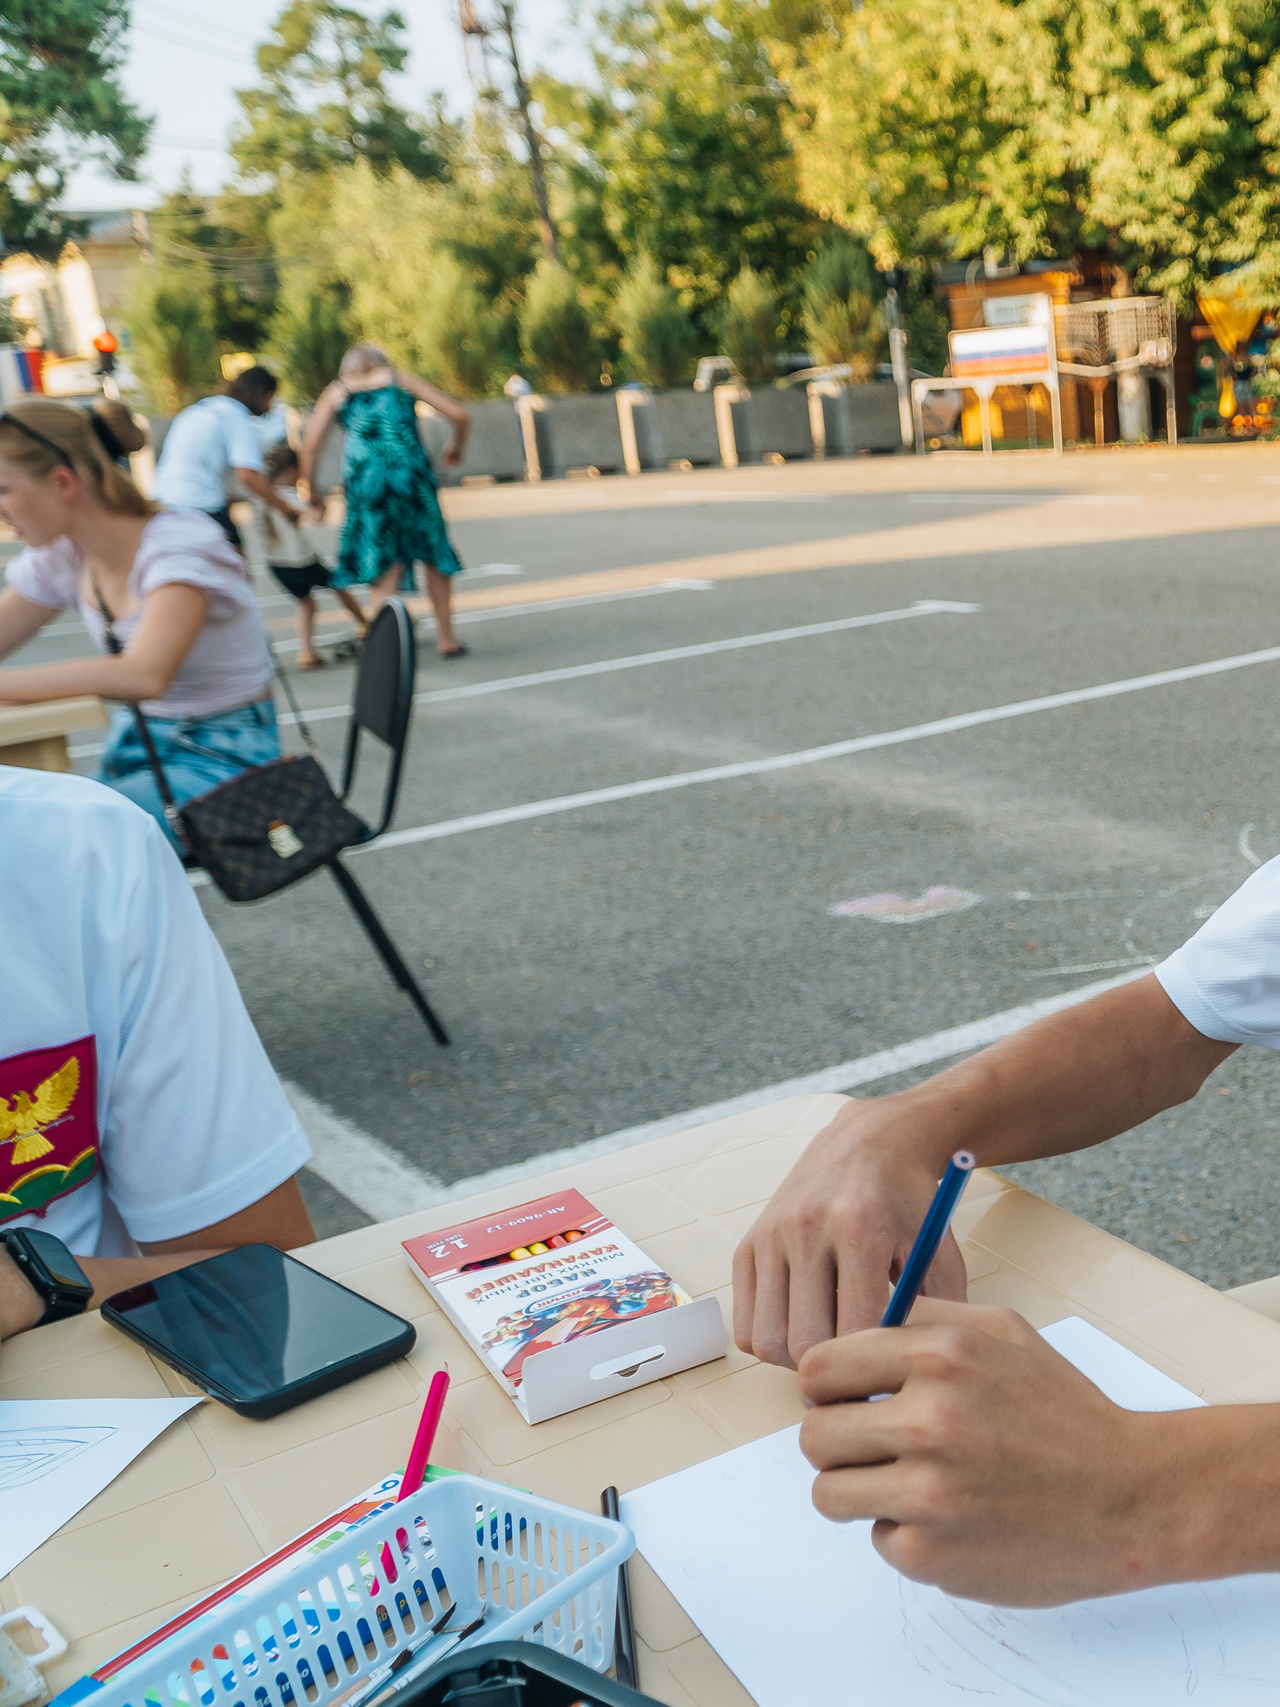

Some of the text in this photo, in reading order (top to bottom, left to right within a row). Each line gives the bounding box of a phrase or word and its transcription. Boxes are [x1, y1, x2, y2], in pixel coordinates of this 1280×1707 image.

[429, 1238, 469, 1259] 12
[465, 1244, 619, 1300] КАРАНДАШЕЙ
[475, 1252, 624, 1305] МЯГКИХ ЦВЕТНЫХ
[517, 1269, 597, 1298] НАБОР
